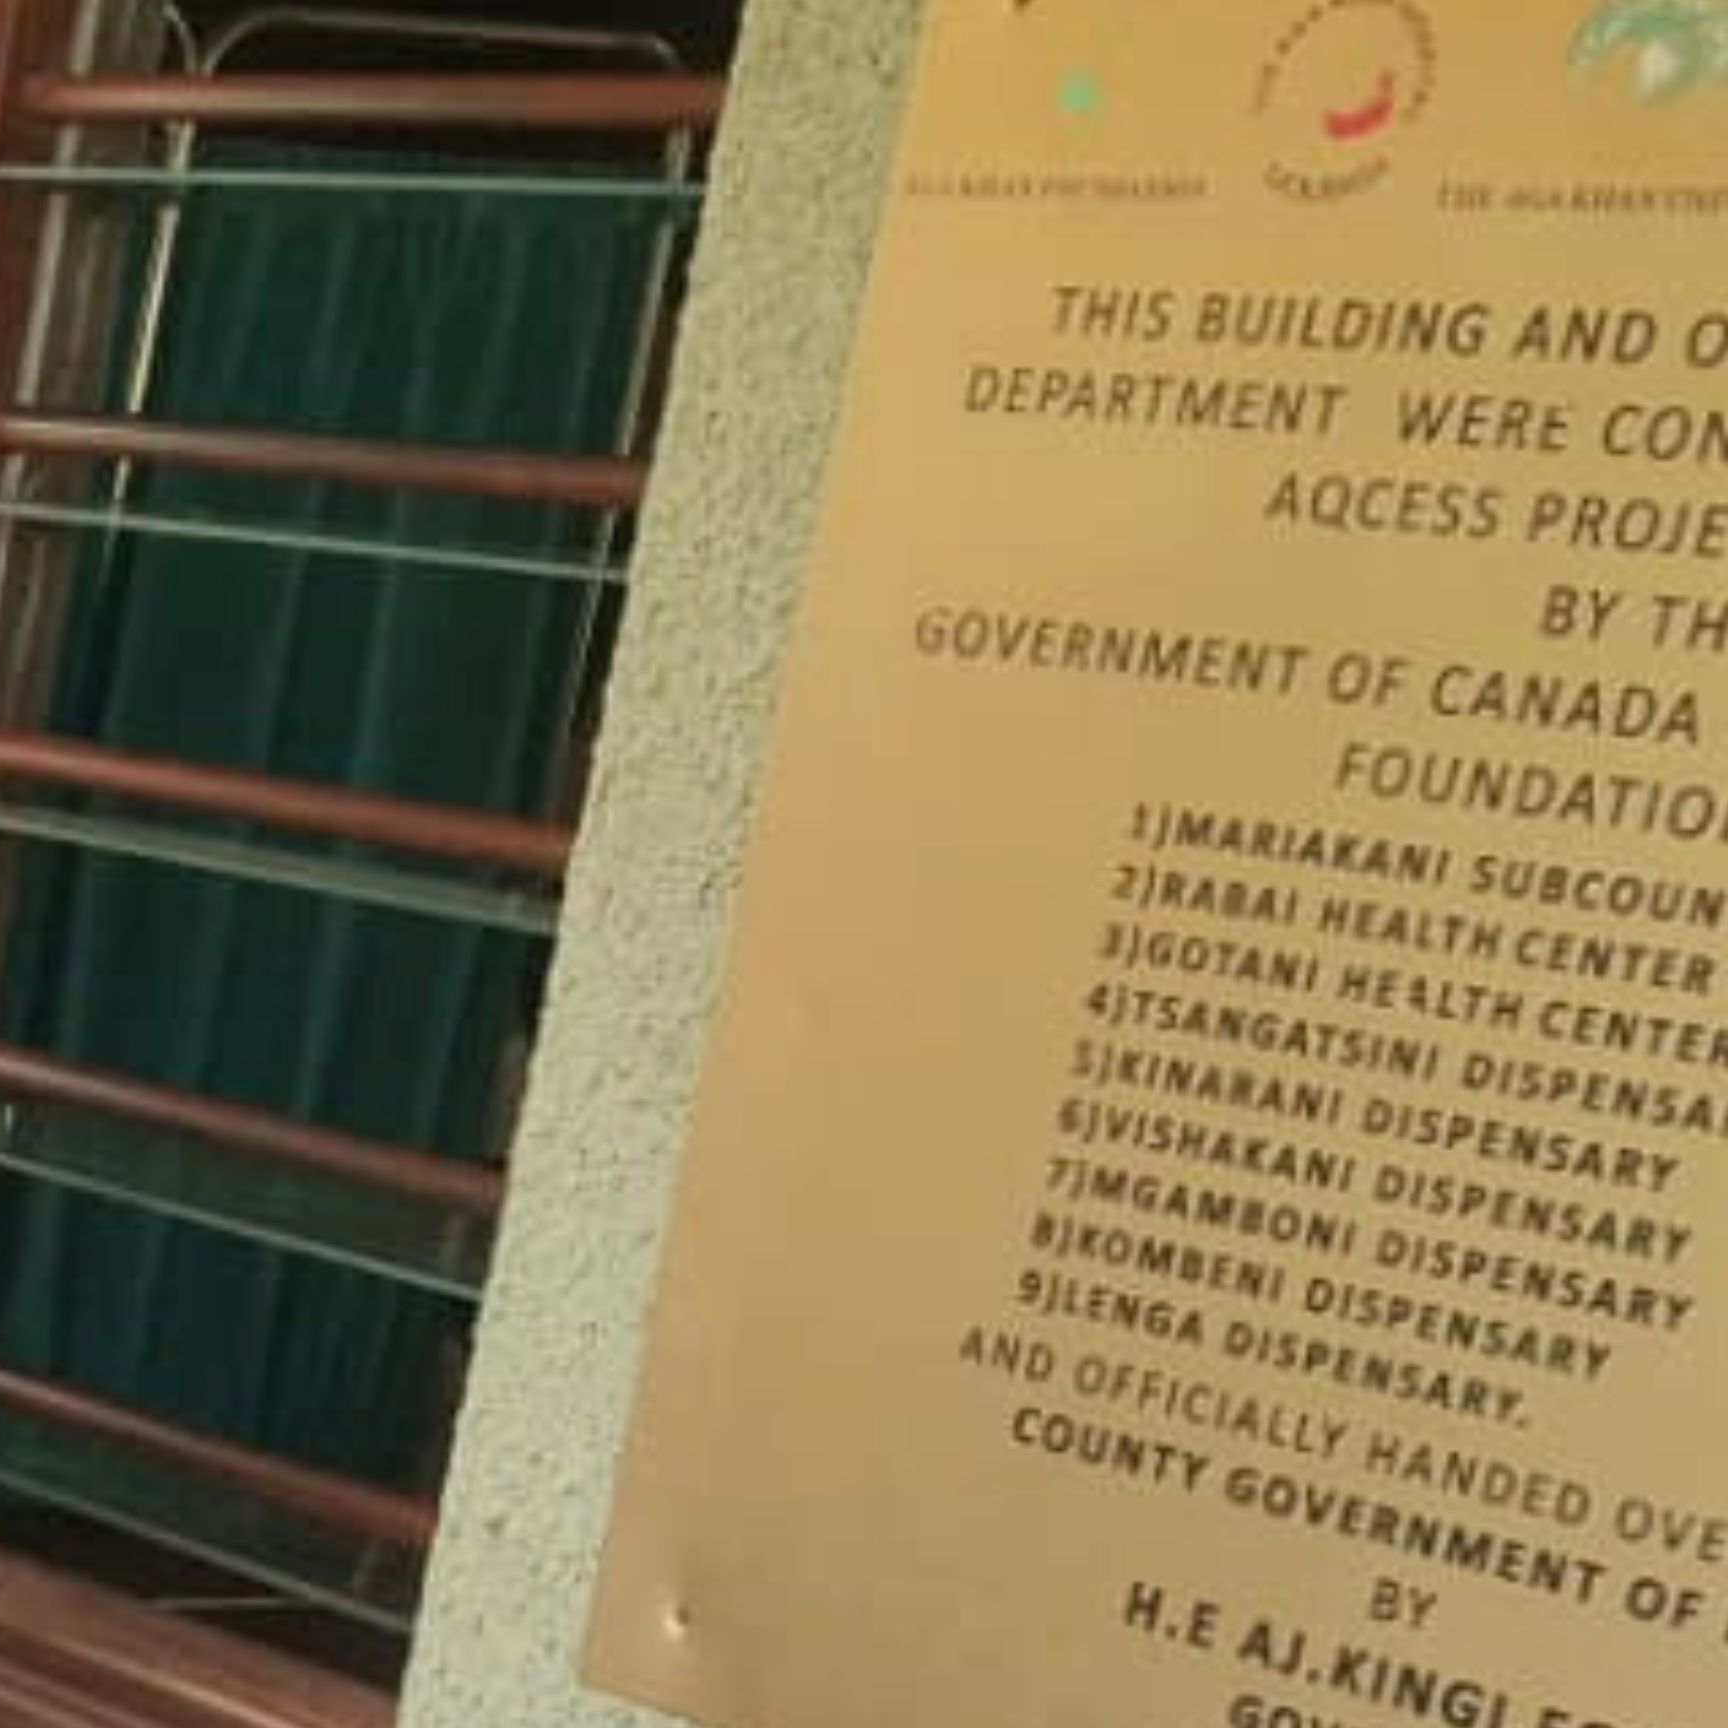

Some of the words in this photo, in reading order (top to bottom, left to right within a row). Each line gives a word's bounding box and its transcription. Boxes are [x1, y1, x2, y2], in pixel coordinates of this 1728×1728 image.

[1052, 285, 1176, 342] THIS
[1195, 290, 1492, 358] BUILDING
[1512, 305, 1659, 364] AND
[964, 365, 1350, 437] DEPARTMENT
[1396, 390, 1572, 452] WERE
[1263, 470, 1504, 540] AQCESS
[1526, 490, 1728, 559] PROJE
[1540, 584, 1621, 643] BY
[915, 605, 1311, 694] GOVERNMENT
[1327, 651, 1410, 706] OF
[1429, 664, 1700, 745] CANADA
[1130, 801, 1452, 885] 1)MARIAKANI
[1334, 740, 1728, 843] FOUNDATIO
[1098, 921, 1318, 992] 3)GOTANI
[1336, 962, 1524, 1028] HEALTH
[1112, 862, 1298, 926] 2)RABAI
[1317, 898, 1505, 958] HEALTH
[1515, 928, 1716, 996] CENTER
[1085, 982, 1440, 1081] 4)TSANGATSINI
[1071, 1038, 1344, 1126] 5)KINARANI
[1361, 1097, 1680, 1194] DISPENSARY
[1057, 1098, 1357, 1193] 6)VISHAKANI
[1373, 1164, 1693, 1265] DISPENSARY
[1030, 1212, 1287, 1302] 8)KOMBENI
[1304, 1276, 1612, 1382] DISPENSARY
[1047, 1158, 1357, 1256] 7)MGAMBONI
[1375, 1228, 1694, 1332] DISPENSARY
[1015, 1269, 1204, 1347] 9)LENGA
[1222, 1319, 1532, 1430] DISPENSARY.
[959, 1325, 1055, 1383] AND
[1073, 1353, 1349, 1459] OFFICIALLY
[1364, 1429, 1591, 1527] HANDED
[1012, 1406, 1210, 1494] COUNTY
[1224, 1466, 1608, 1606] GOVERNMENT
[1625, 1575, 1705, 1629] OF
[1125, 1580, 1221, 1650] H.E
[1369, 1575, 1439, 1630] BY
